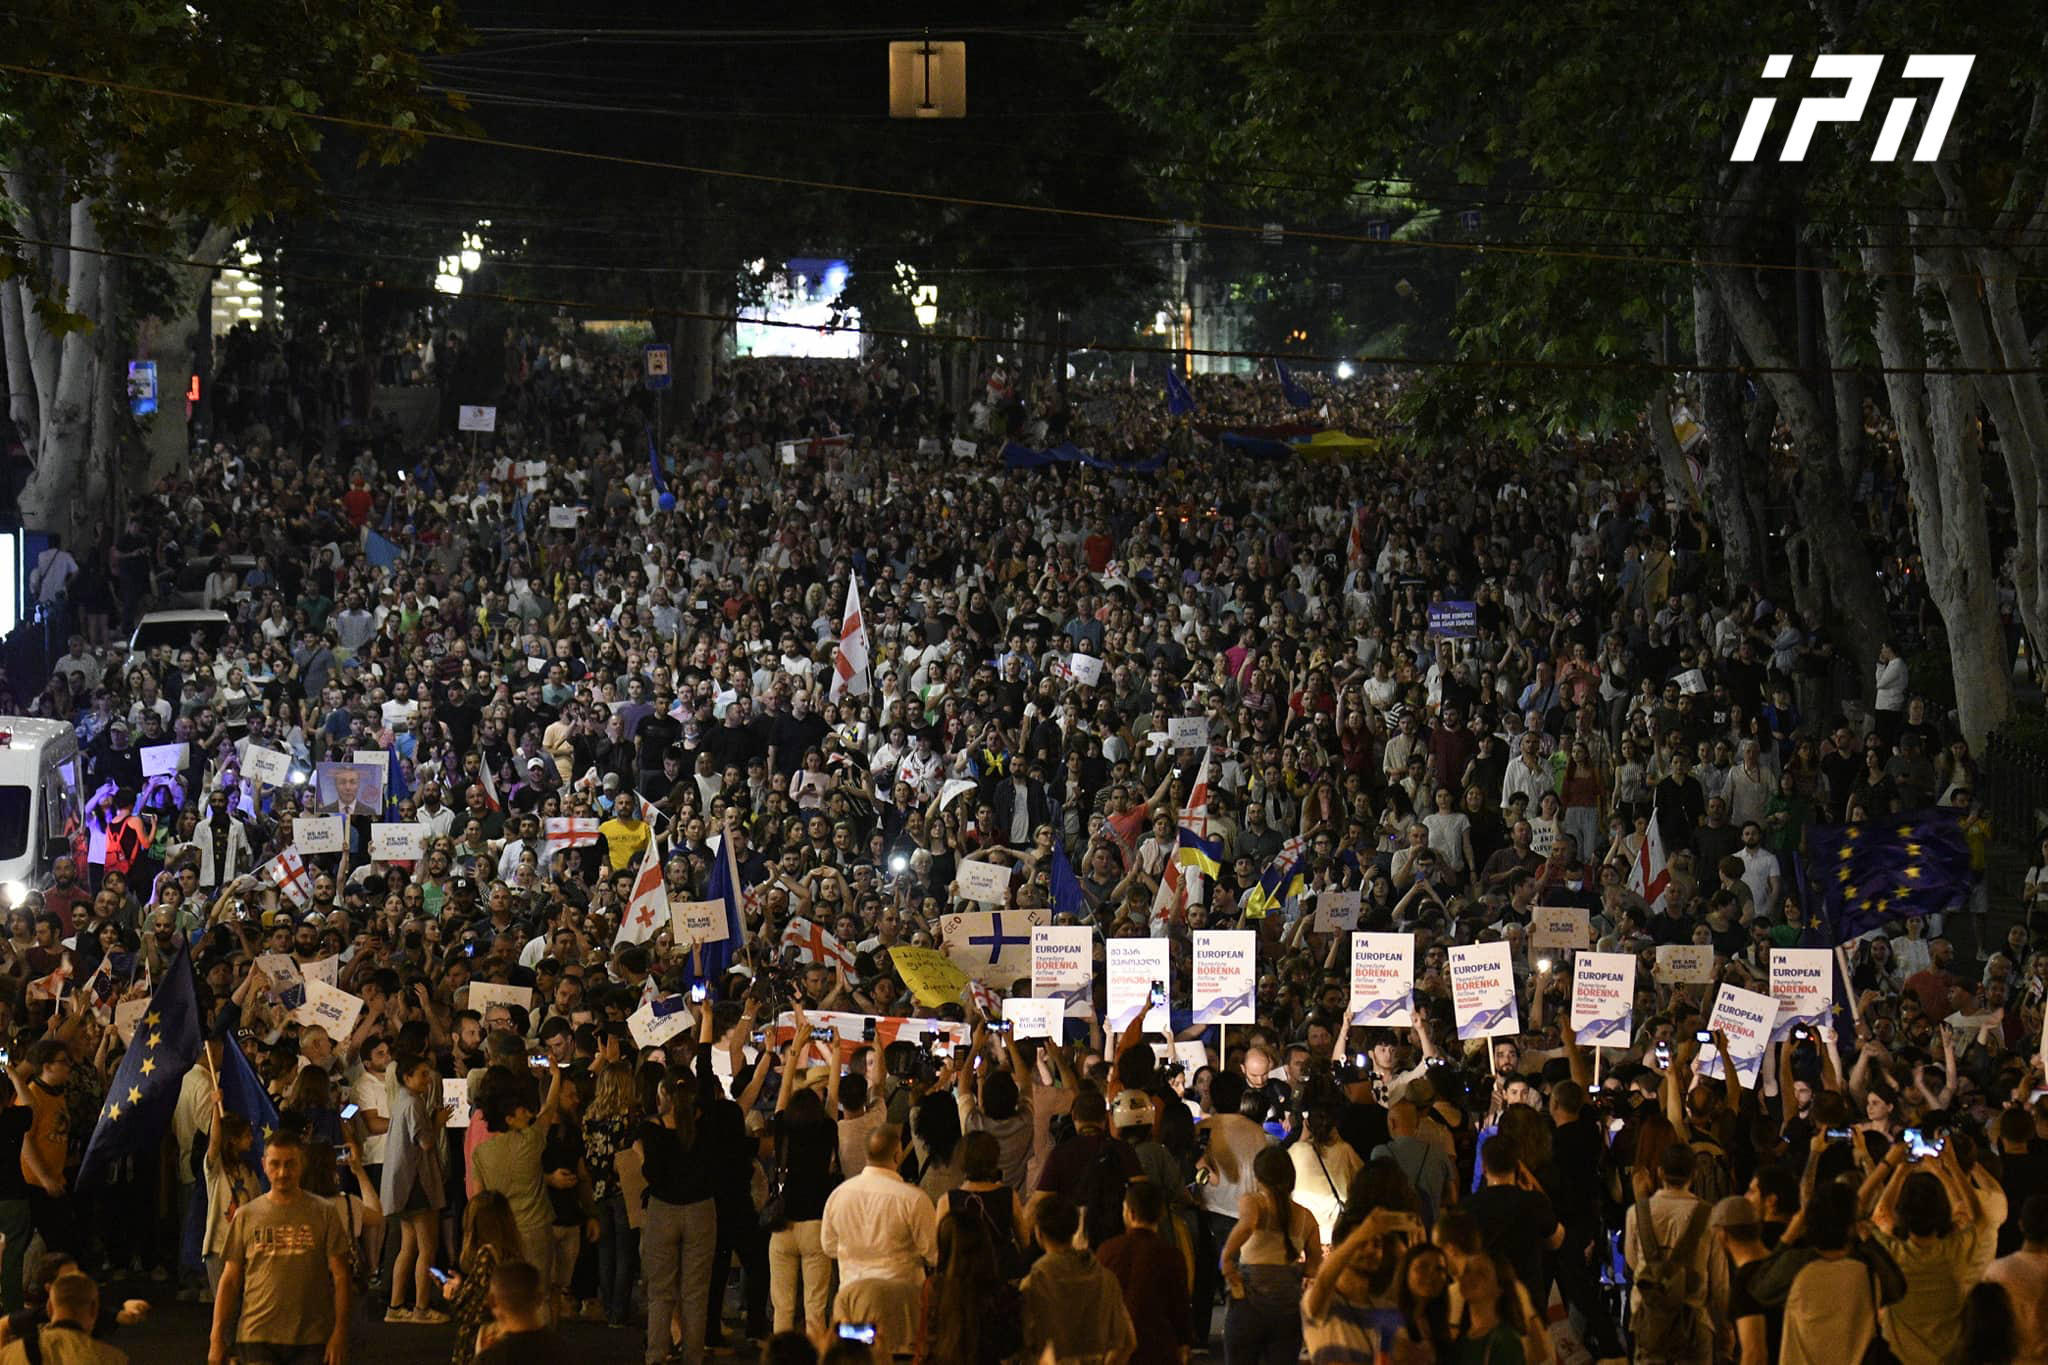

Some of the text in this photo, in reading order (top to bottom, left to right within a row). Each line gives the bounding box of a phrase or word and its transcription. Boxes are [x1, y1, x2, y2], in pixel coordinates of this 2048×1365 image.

[1028, 912, 1044, 926] EU
[944, 916, 962, 934] GEO
[1035, 933, 1048, 941] I'M
[1197, 950, 1244, 958] EUROPEAN
[1355, 952, 1402, 961] EUROPEAN
[1452, 954, 1465, 962] I'M
[1579, 958, 1592, 967] I'M
[1197, 967, 1240, 975] BORENKA
[1355, 969, 1399, 977] BORENKA
[1454, 962, 1500, 975] EUROPEAN
[1773, 968, 1821, 977] EUROPEAN
[1578, 972, 1623, 982] EUROPEAN
[1456, 979, 1500, 991] BORENKA
[1773, 985, 1817, 993] BORENKA
[1577, 987, 1619, 998] BORENKA
[1722, 992, 1735, 1001] I'M
[316, 1006, 340, 1021] EUROPE
[1718, 1003, 1764, 1023] EUROPEAN
[649, 1014, 672, 1032] EUROPE
[1713, 1019, 1755, 1038] BORENKA
[254, 1226, 314, 1250] USA
